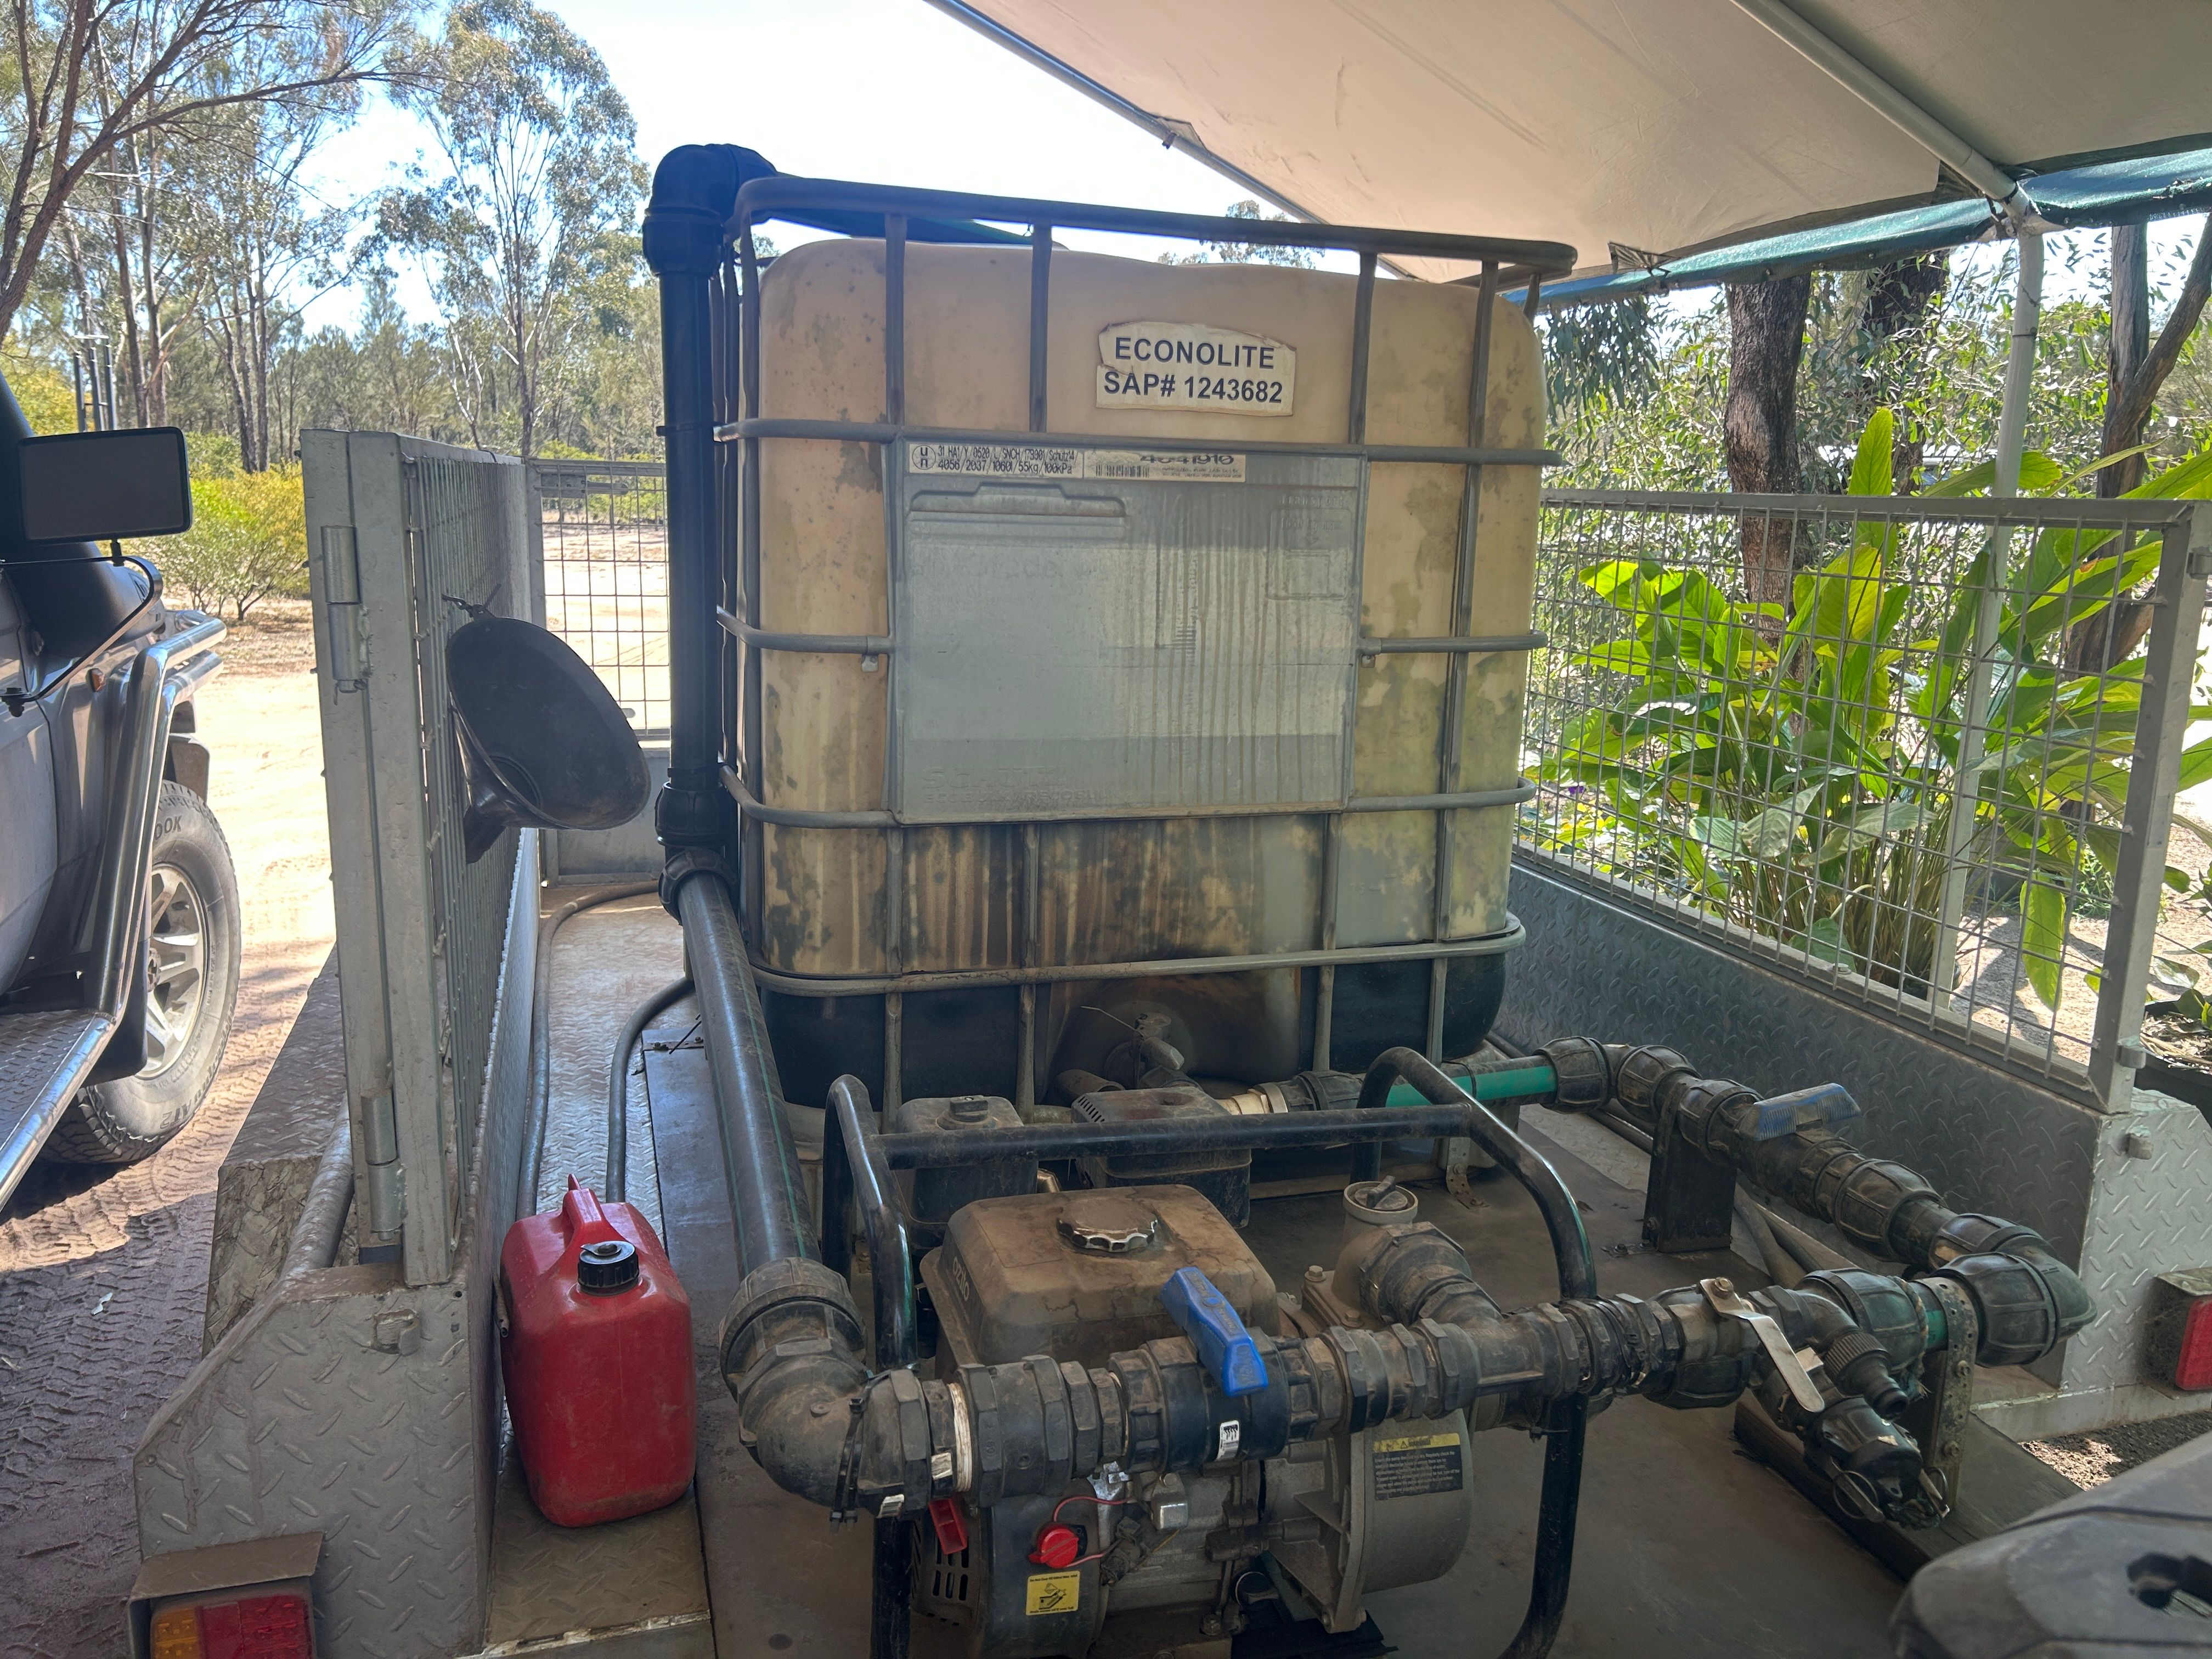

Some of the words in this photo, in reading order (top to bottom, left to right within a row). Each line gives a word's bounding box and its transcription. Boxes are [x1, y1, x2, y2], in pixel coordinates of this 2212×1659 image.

[1115, 336, 1274, 370] ECONOLITE
[1104, 371, 1176, 398] SAP#
[1184, 376, 1283, 404] 1243682
